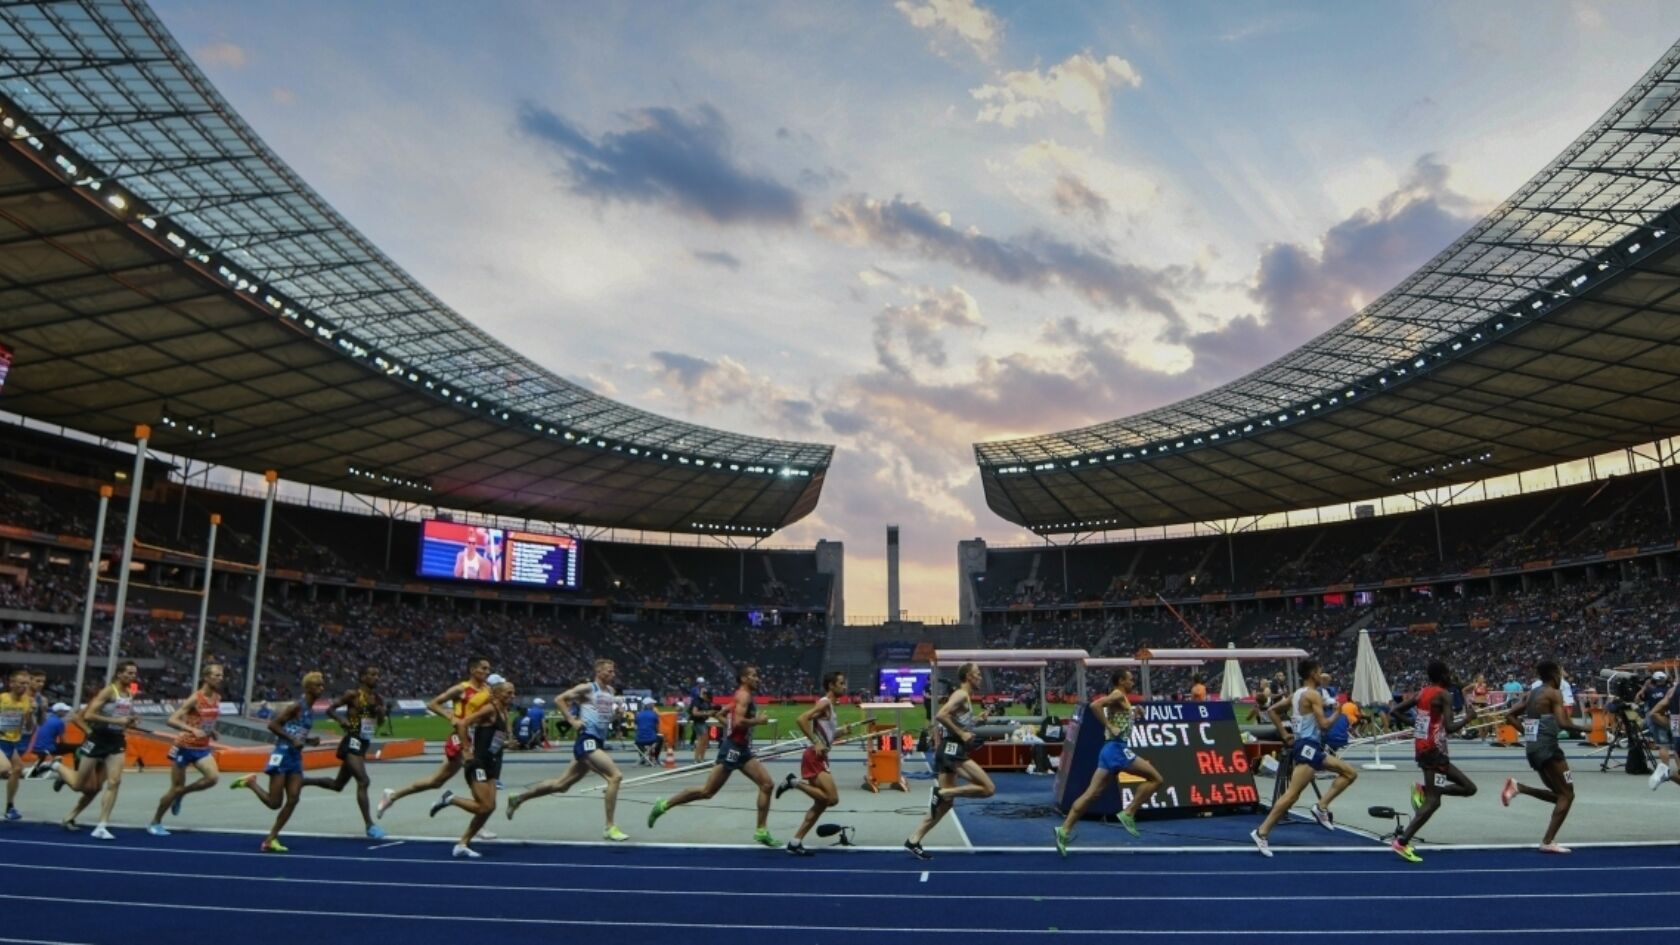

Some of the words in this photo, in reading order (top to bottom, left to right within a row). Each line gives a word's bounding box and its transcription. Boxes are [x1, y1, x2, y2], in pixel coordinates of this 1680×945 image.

[1199, 704, 1210, 719] B
[1198, 722, 1216, 745] C
[1195, 749, 1249, 775] Rk.6
[1190, 782, 1257, 805] 4.45m
